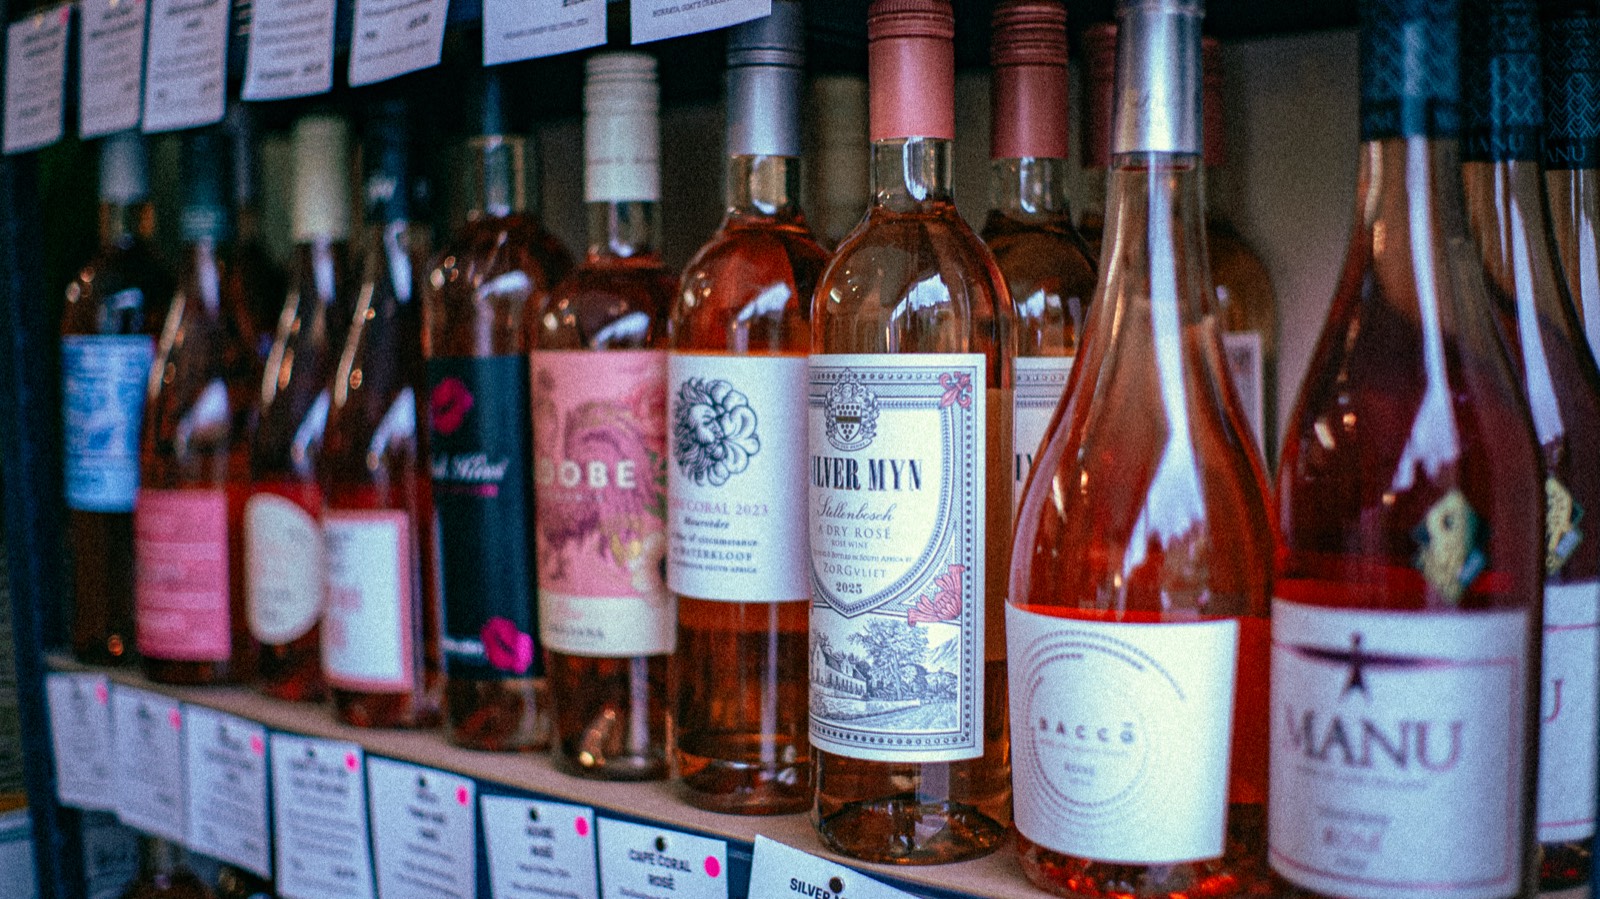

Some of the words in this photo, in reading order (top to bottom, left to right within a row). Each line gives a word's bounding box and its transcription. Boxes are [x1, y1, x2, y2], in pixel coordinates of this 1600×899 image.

[538, 460, 636, 488] DOBE
[811, 455, 861, 491] ILVER
[867, 457, 923, 493] MYN
[826, 524, 849, 537] DRY
[1285, 704, 1463, 772] MANU
